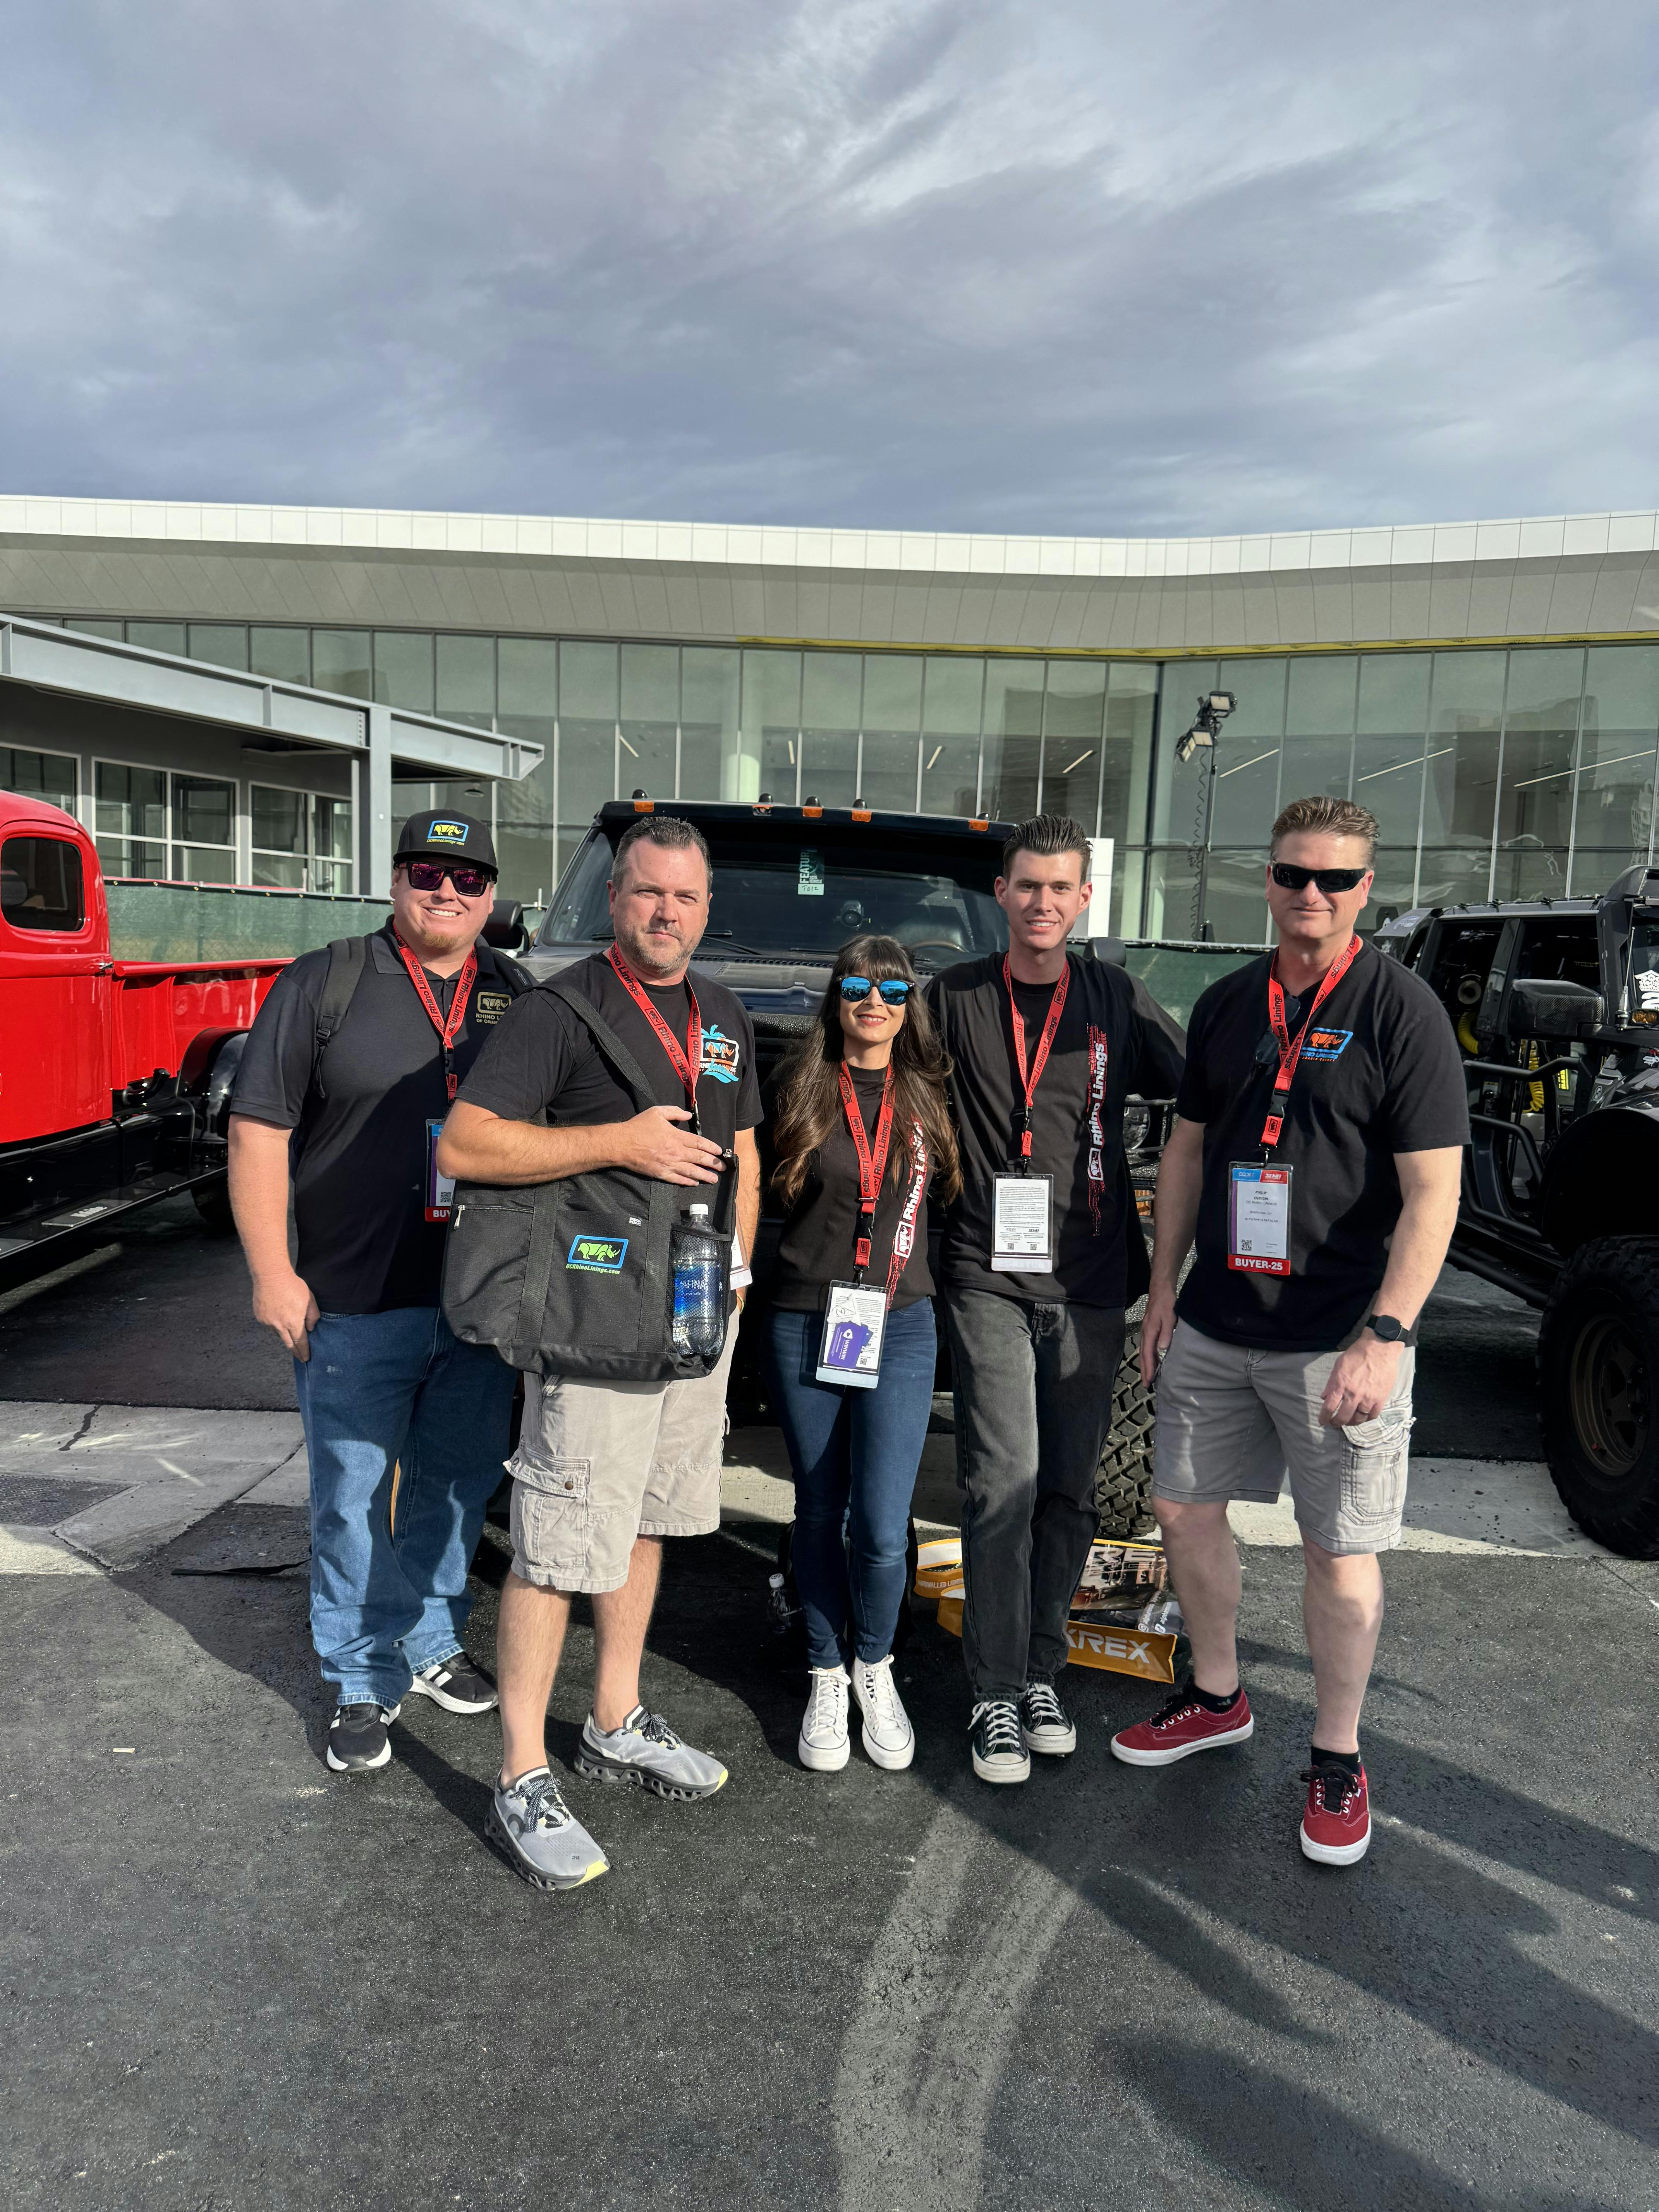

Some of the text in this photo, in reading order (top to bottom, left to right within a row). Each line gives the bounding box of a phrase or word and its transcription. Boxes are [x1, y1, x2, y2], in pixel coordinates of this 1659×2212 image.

[799, 850, 810, 883] FEATUR
[408, 959, 438, 1015] Rhino Linings
[618, 966, 643, 996] Linings
[448, 981, 469, 1033] Rhino Linings
[1273, 992, 1283, 1023] Linings
[658, 1026, 676, 1053] Rhino
[1036, 1046, 1048, 1071] Rhino
[1088, 1040, 1108, 1146] Rhino Linings
[856, 1135, 867, 1158] Rhino
[873, 1118, 890, 1176] Rhino Linings
[902, 1174, 924, 1221] Rhino
[565, 1263, 620, 1275] OCRhinoLinings.com
[1235, 1258, 1283, 1271] BUYER-25
